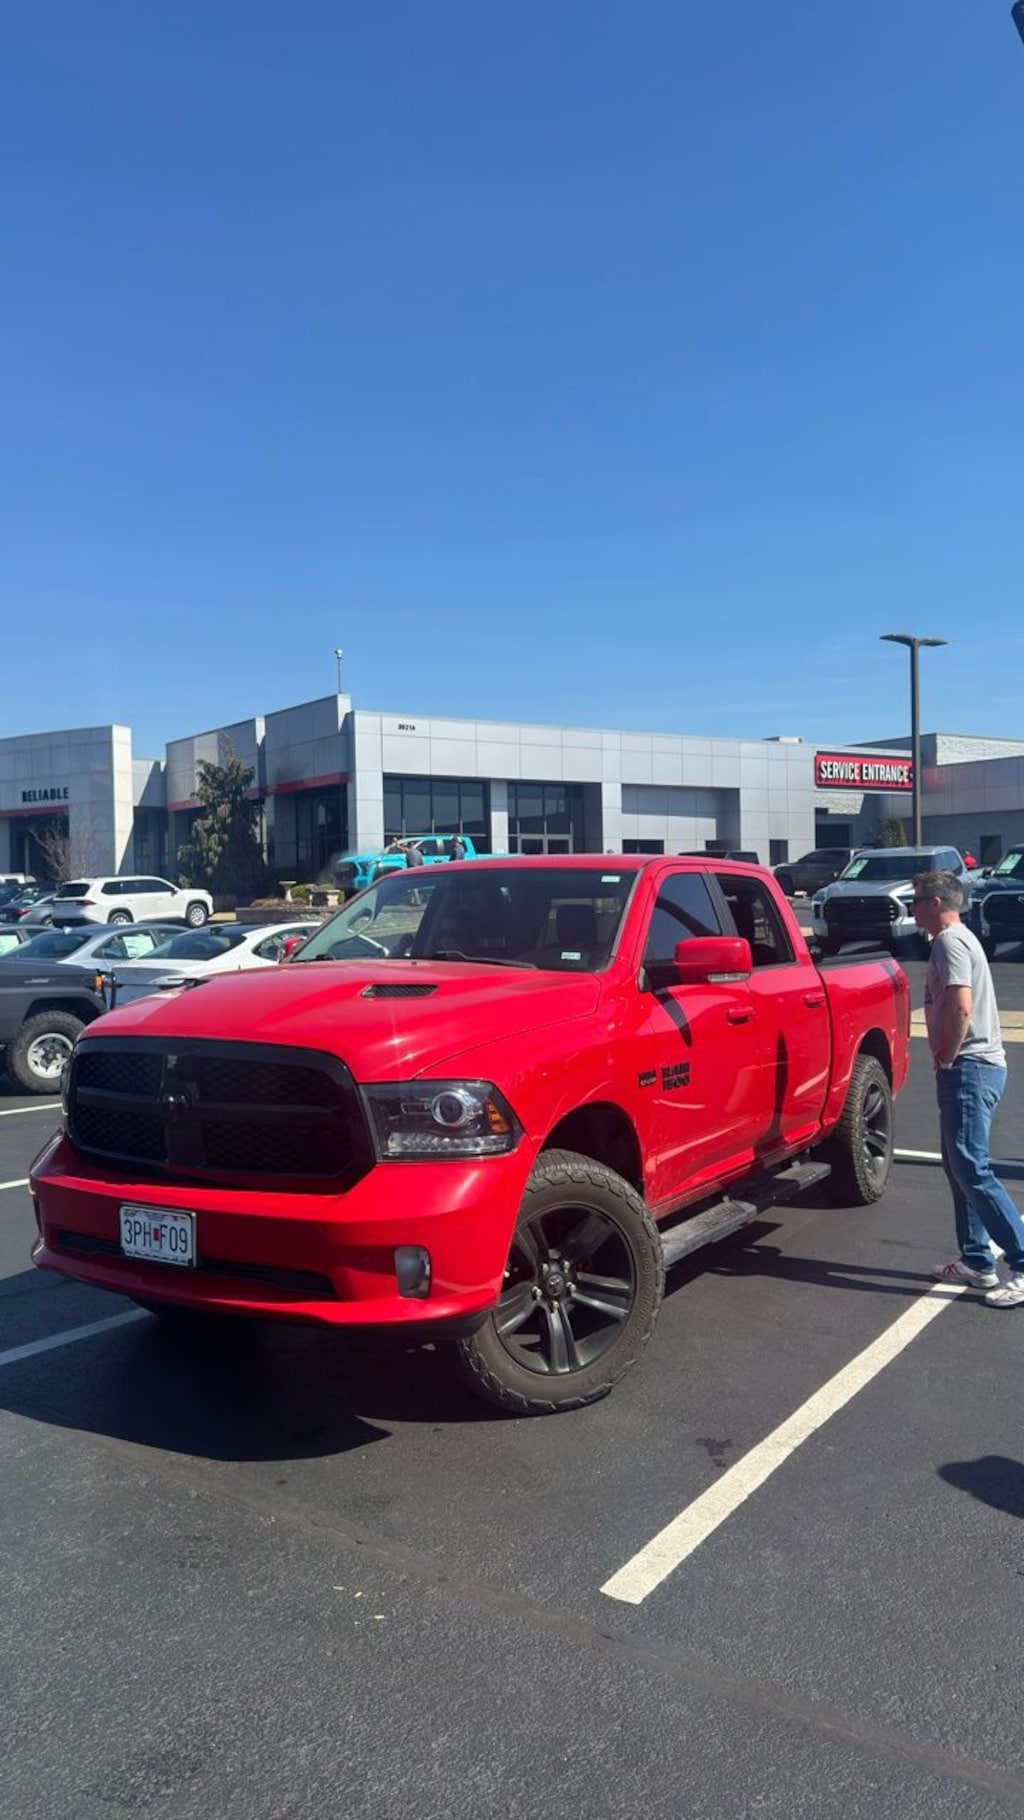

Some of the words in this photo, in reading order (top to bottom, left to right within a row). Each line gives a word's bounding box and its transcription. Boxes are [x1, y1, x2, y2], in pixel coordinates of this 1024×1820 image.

[820, 761, 860, 780] SERVICE
[862, 763, 908, 783] ENTRANCE
[22, 787, 69, 802] RELIABLE
[124, 1219, 152, 1248] 3PH
[160, 1225, 188, 1254] F09
